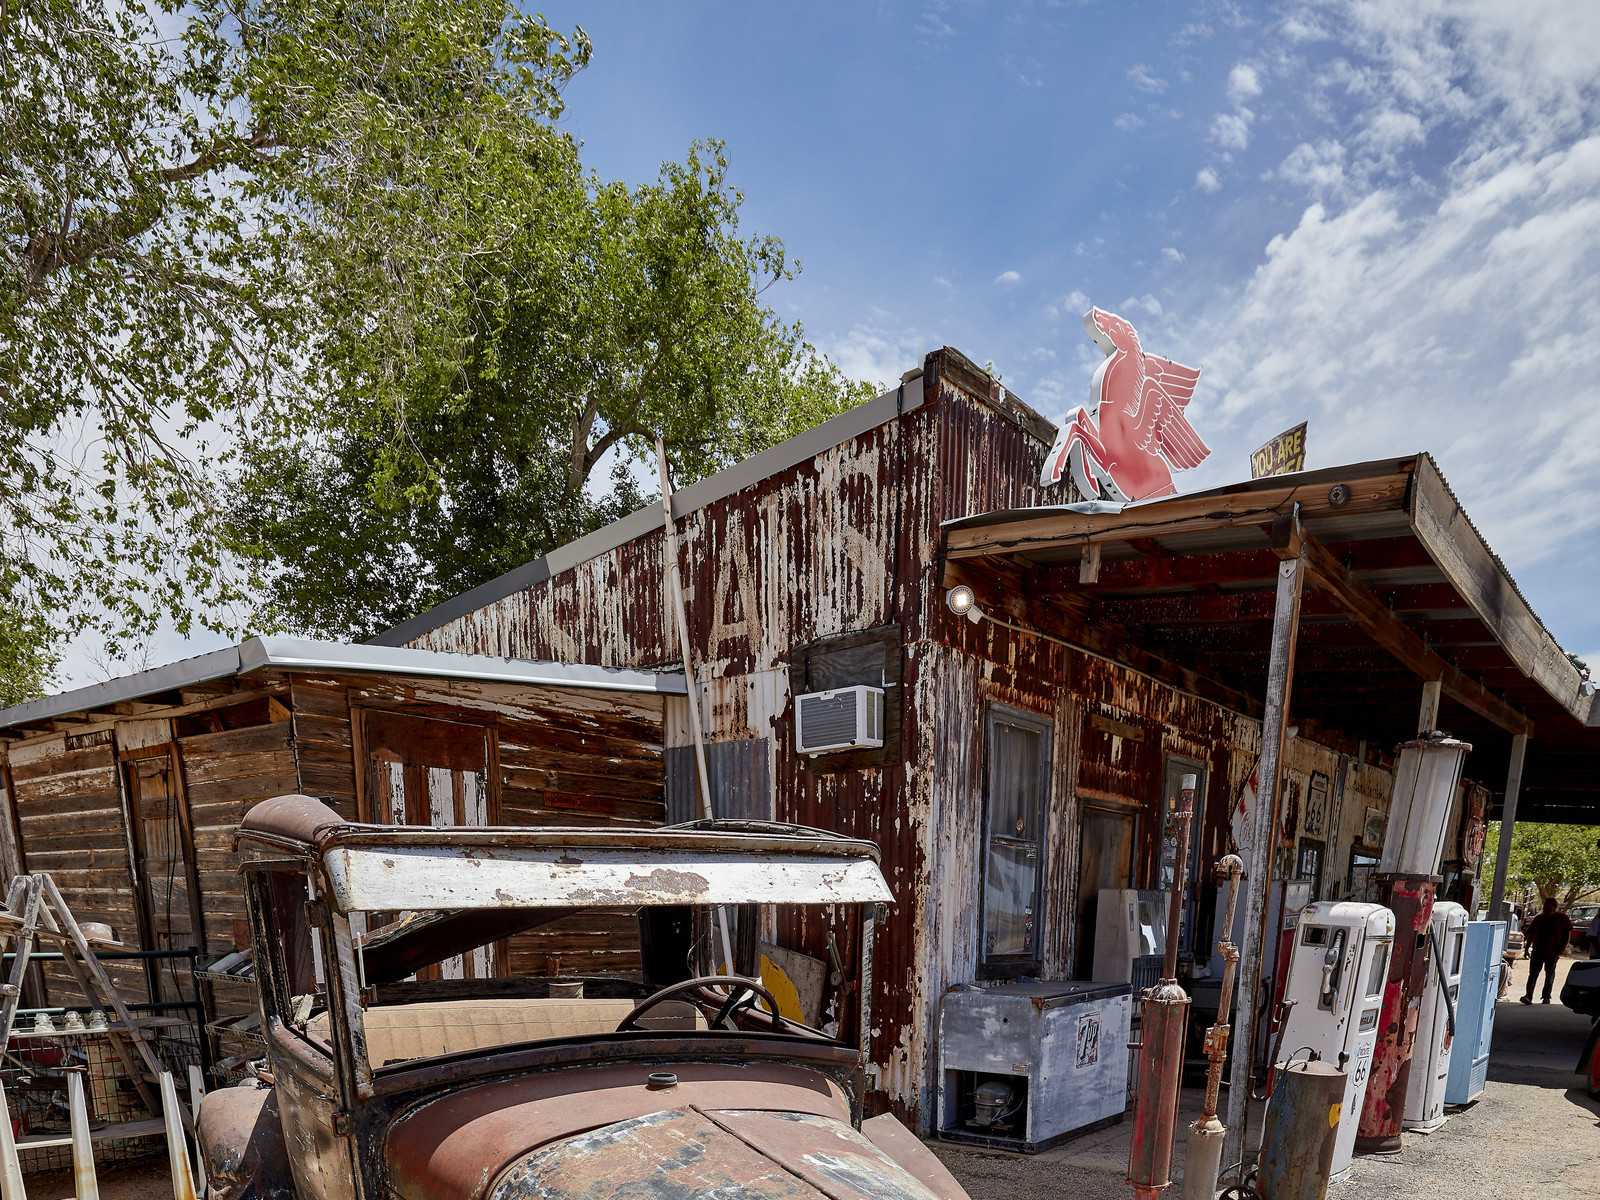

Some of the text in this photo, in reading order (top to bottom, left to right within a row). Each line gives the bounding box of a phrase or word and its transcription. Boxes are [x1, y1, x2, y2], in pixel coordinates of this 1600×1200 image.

[1254, 445, 1273, 478] YOU
[1277, 431, 1302, 464] ARE
[1310, 801, 1321, 823] 66
[1355, 1060, 1367, 1082] 66
